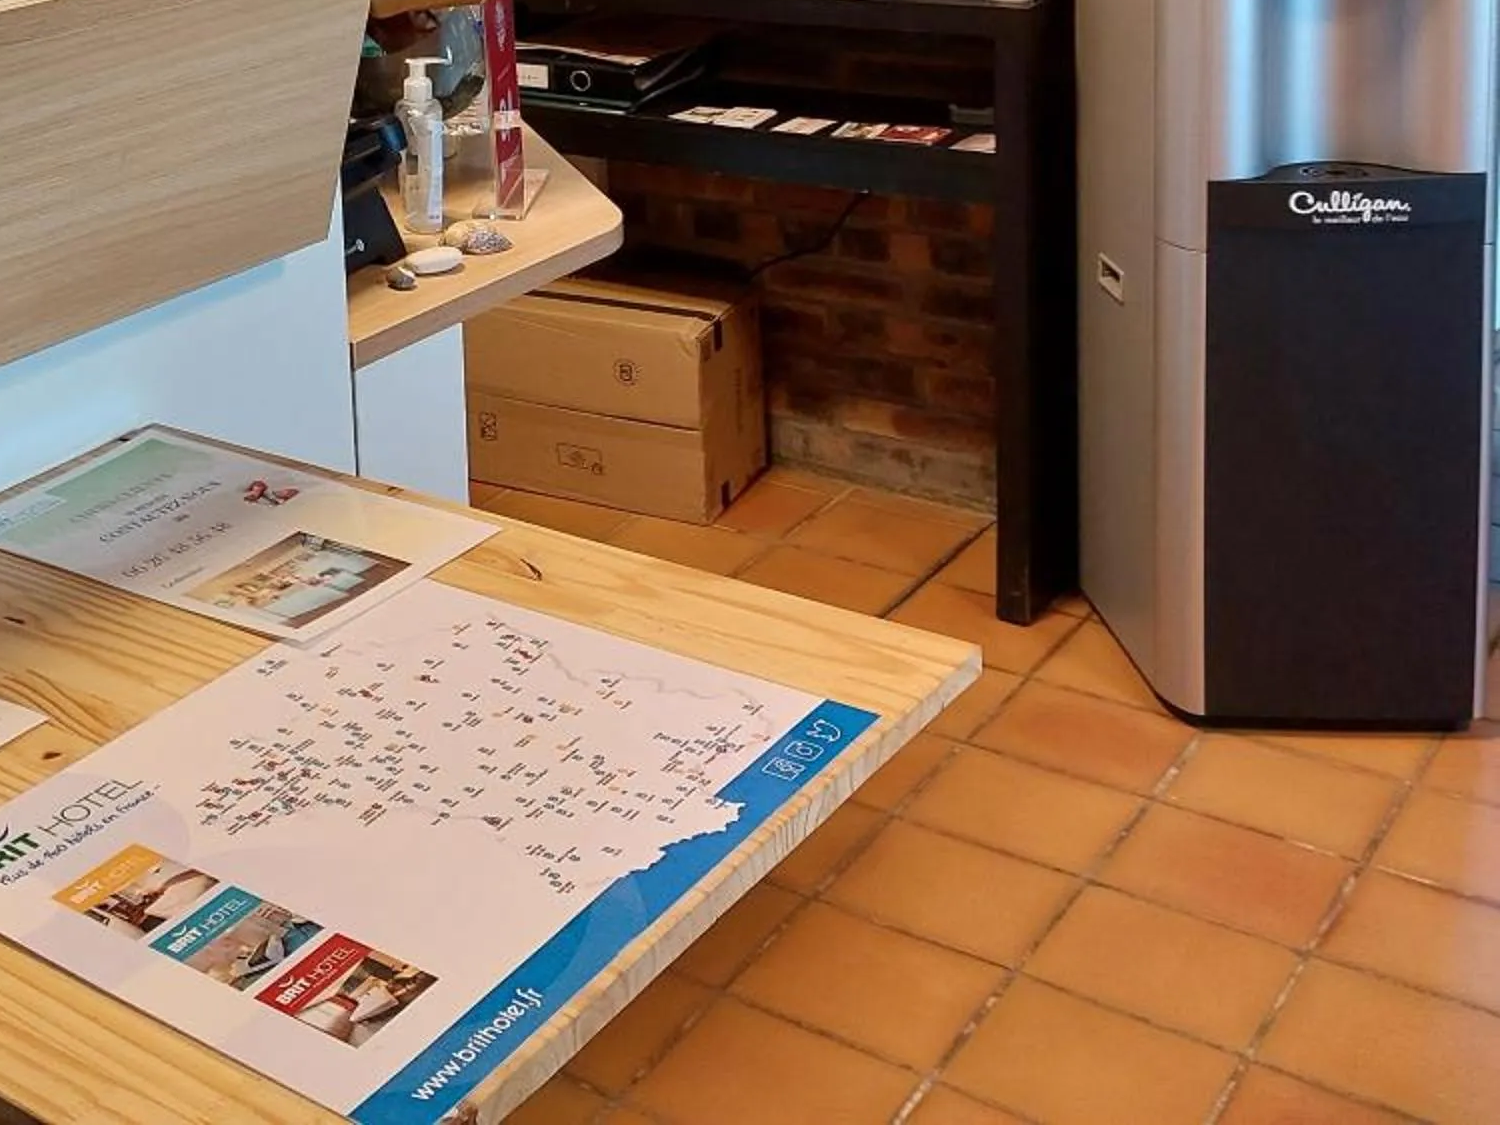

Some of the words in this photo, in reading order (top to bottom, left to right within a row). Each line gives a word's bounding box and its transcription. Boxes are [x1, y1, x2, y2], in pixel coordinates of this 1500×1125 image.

[37, 779, 144, 836] HOTEL
[27, 858, 45, 870] de
[102, 814, 117, 824] en
[166, 928, 203, 954] BRIT
[201, 898, 249, 933] HOTEL
[276, 979, 313, 1005] BRIT
[311, 946, 357, 981] HOTEL
[411, 987, 543, 1100] www.brithotel.fr
